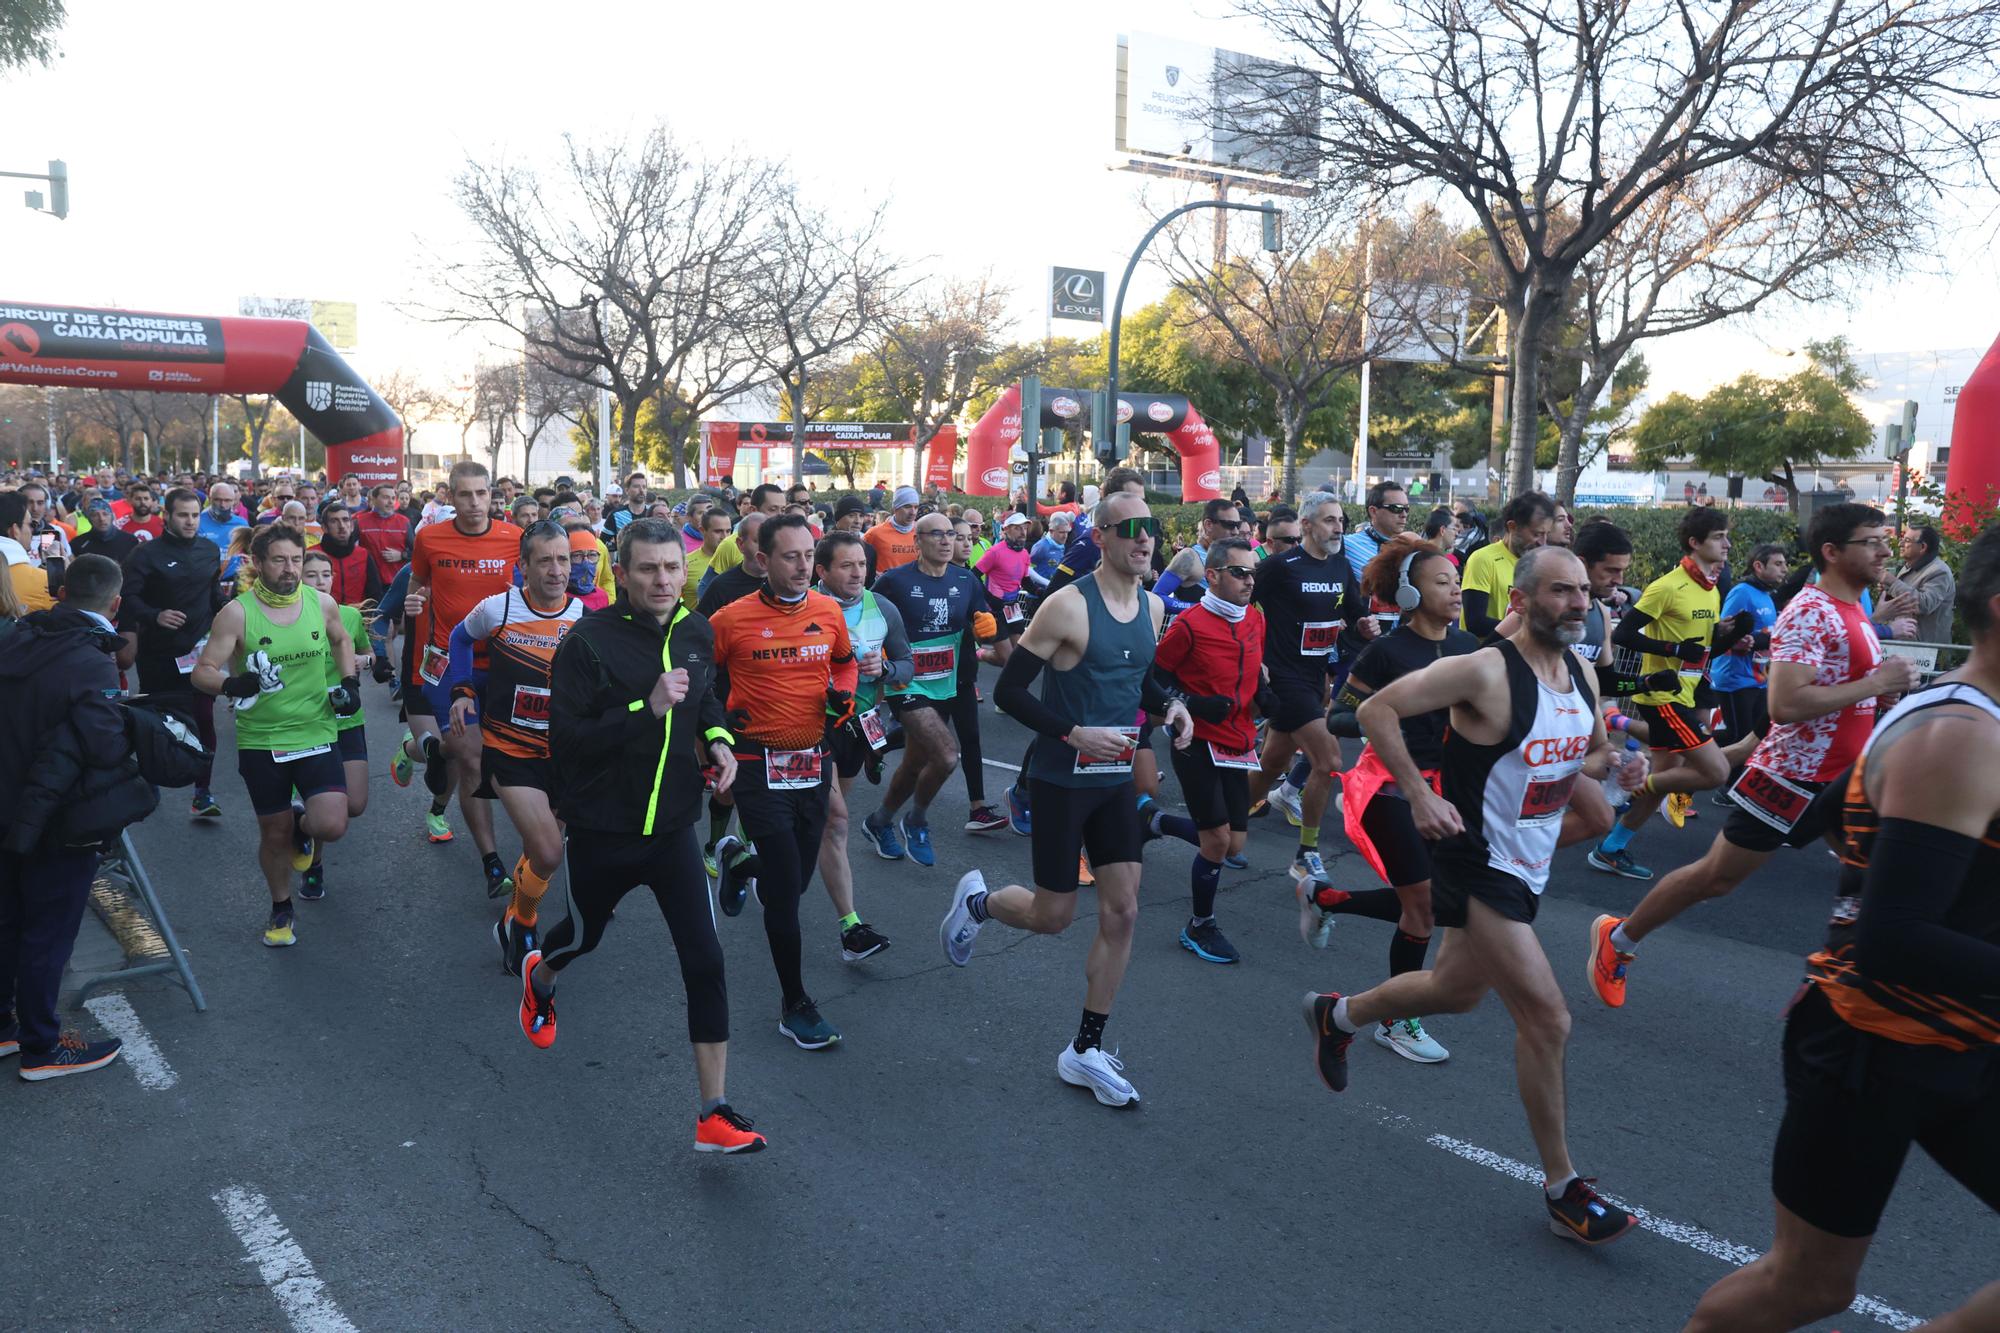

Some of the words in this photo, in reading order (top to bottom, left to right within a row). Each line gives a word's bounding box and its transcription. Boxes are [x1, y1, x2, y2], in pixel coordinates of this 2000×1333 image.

[1056, 303, 1101, 315] LEXUS
[73, 313, 101, 325] DE
[103, 315, 204, 332] CARRERES
[0, 362, 118, 378] #ValènciaCorre
[438, 560, 476, 568] NEVER
[479, 559, 506, 568] STOP
[505, 637, 535, 646] QUART
[752, 647, 798, 660] NEVER
[800, 644, 829, 657] STOP
